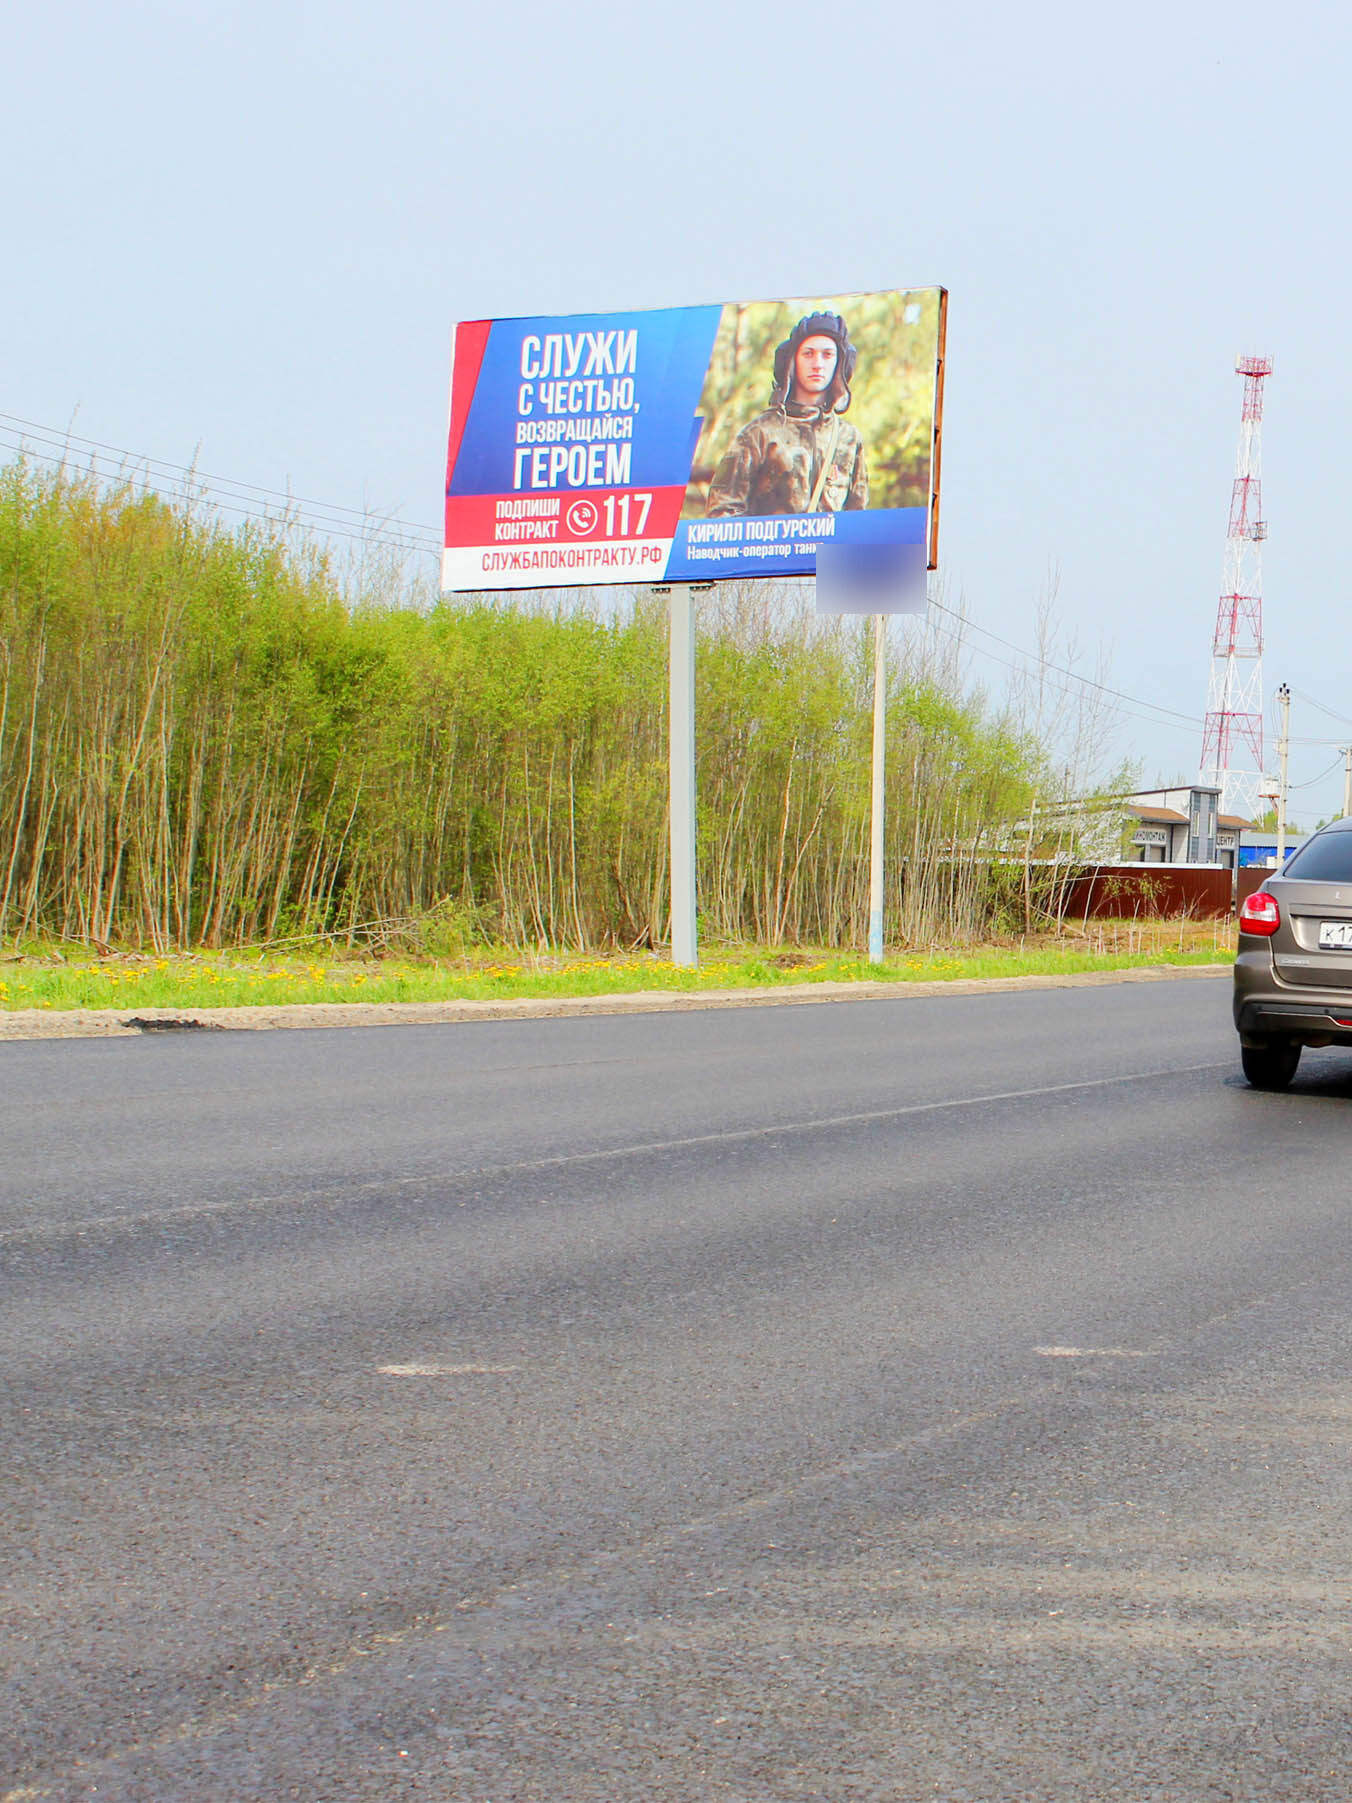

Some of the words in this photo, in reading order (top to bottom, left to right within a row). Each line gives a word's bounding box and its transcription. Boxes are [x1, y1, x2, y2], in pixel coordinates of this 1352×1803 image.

[520, 329, 638, 380] СЛУЖИ
[518, 383, 534, 416] С
[539, 377, 641, 414] ЧЕСТЬЮ,
[516, 412, 633, 444] ВОЗВРАЩАЙСЯ
[513, 442, 632, 489] ГЕРОЕМ
[495, 498, 561, 520] ПОДПИШИ
[603, 493, 653, 537] 117
[495, 520, 559, 541] КОНТРАКТ
[688, 522, 743, 543] КИРИЛЛ
[746, 514, 836, 541] ПОДГУРСКИЙ
[481, 545, 662, 572] СЛУЖБАПОКОНТРАКТУ.РФ
[687, 544, 792, 560] Наводчик-оператор
